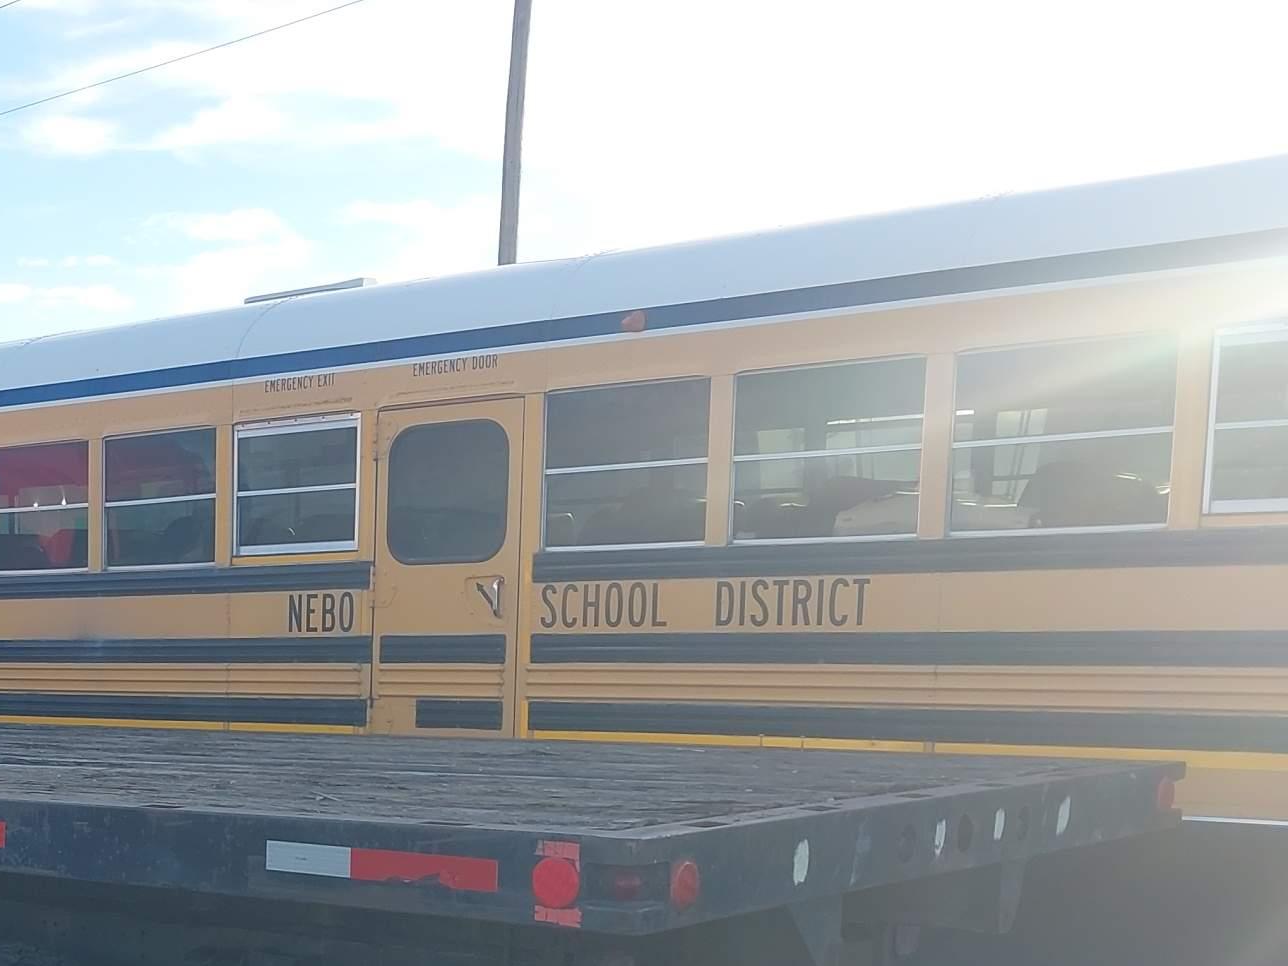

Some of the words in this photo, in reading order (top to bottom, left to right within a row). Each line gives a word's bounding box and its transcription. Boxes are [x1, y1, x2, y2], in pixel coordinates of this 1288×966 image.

[413, 357, 467, 377] EMERGENCY
[471, 353, 498, 370] DOOR
[264, 374, 314, 393] EMERGENCY
[317, 372, 337, 388] EXIT
[288, 591, 354, 633] NEBO
[539, 581, 668, 629] SCHOOL
[714, 577, 872, 628] DISTRICT
